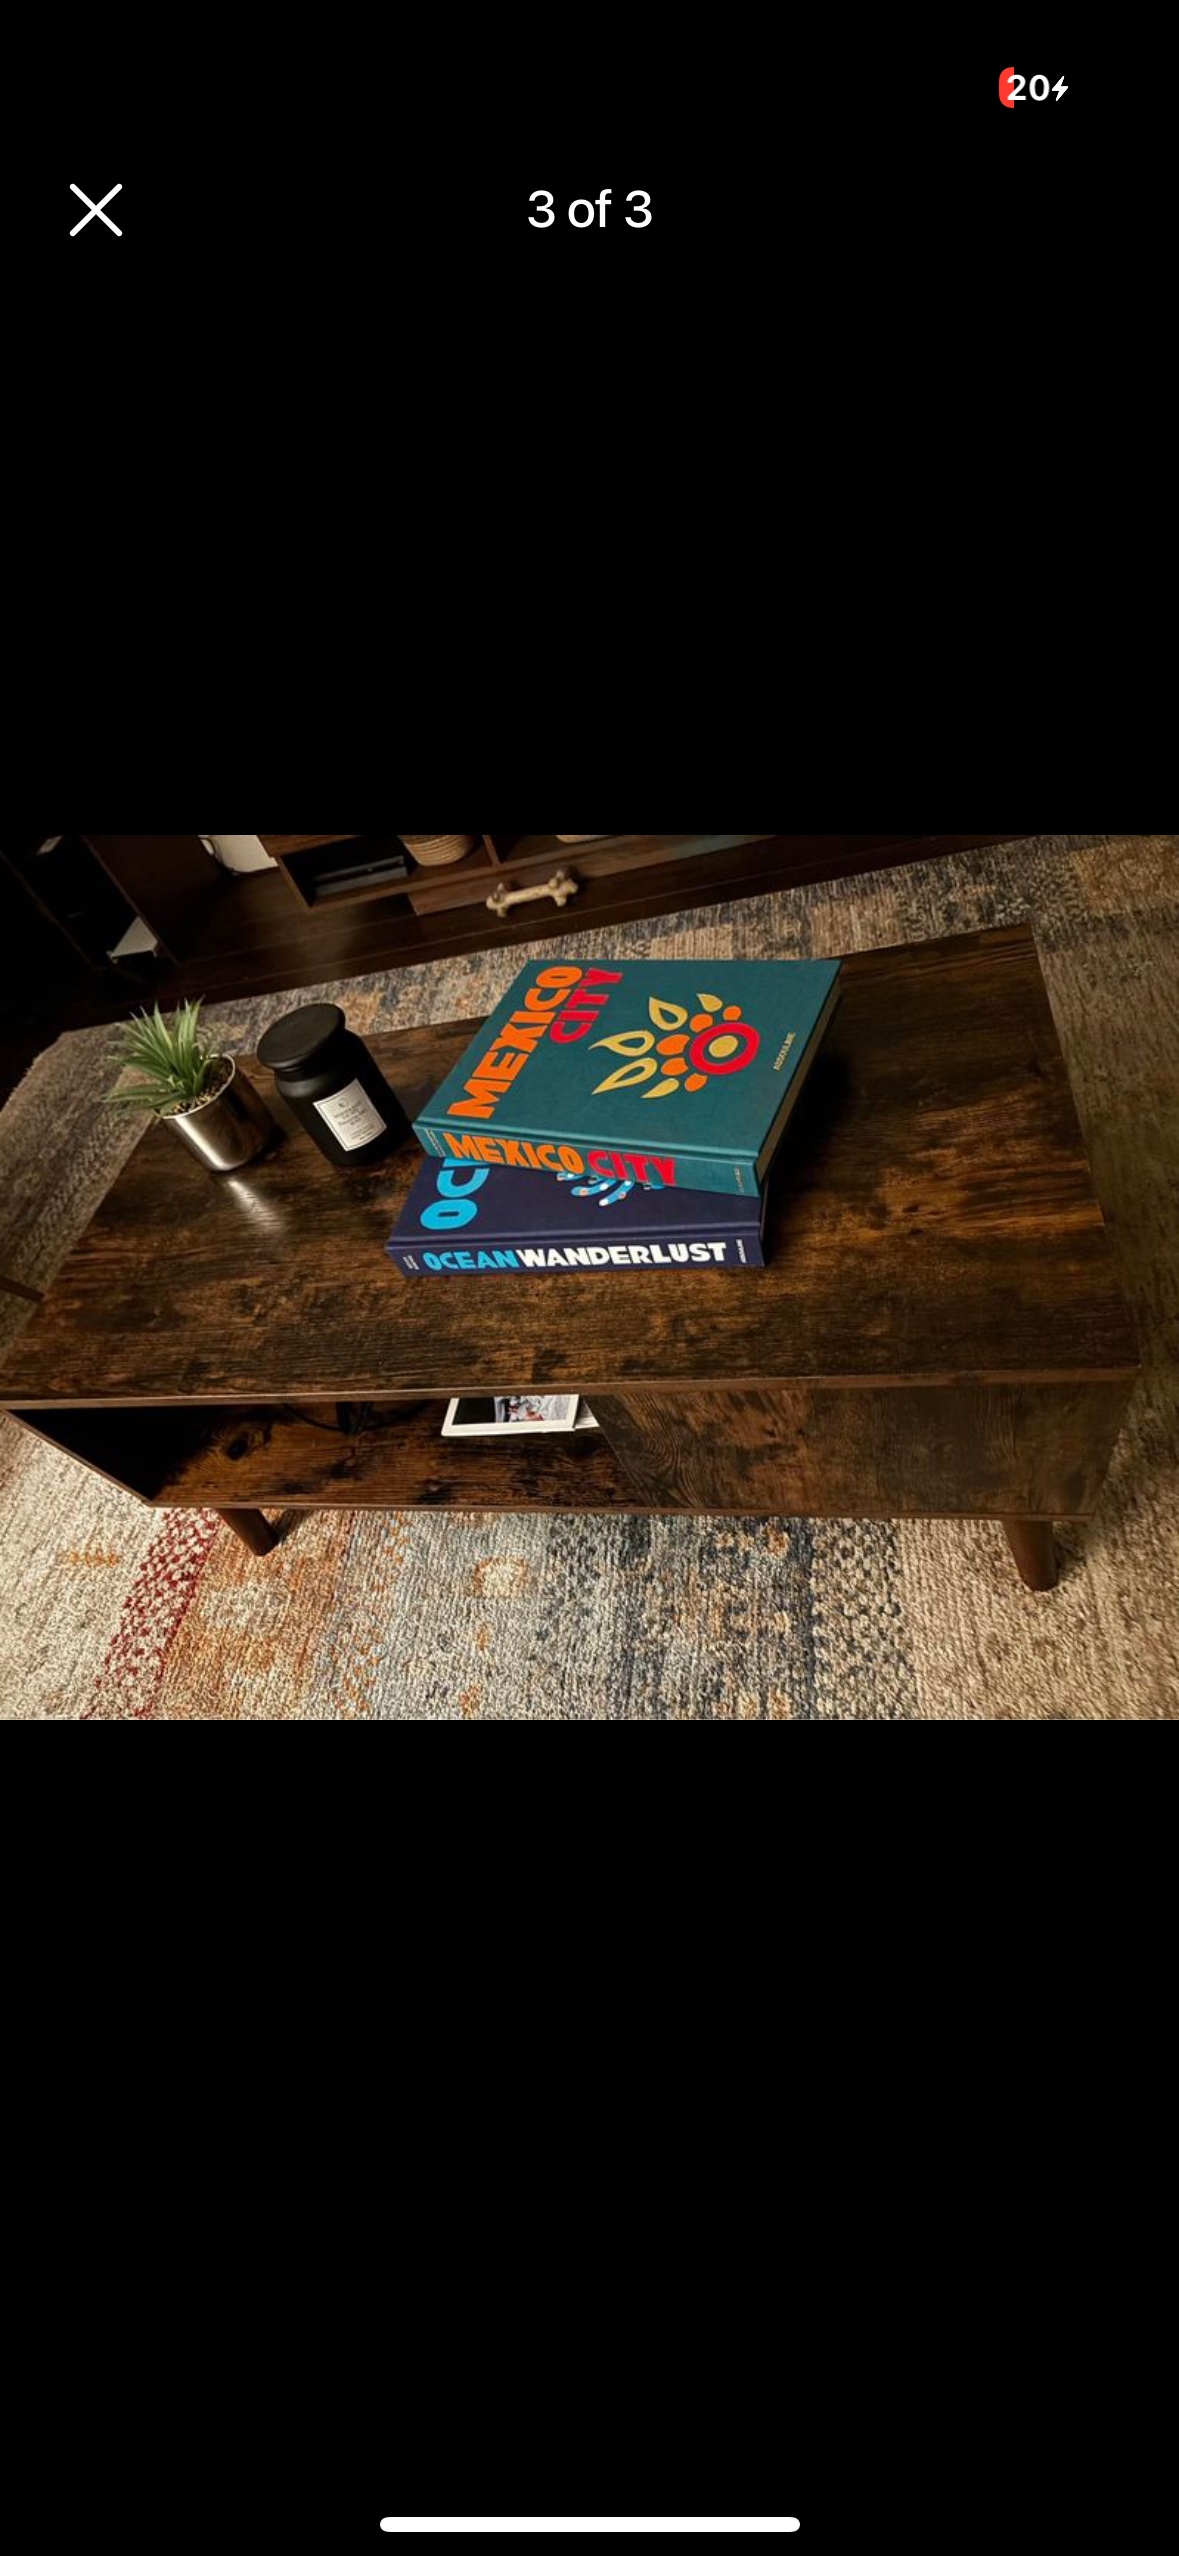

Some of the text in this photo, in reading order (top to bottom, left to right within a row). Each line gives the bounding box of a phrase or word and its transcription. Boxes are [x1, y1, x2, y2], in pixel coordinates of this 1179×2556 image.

[447, 966, 583, 1119] MEXICO
[549, 967, 623, 1044] CITY
[443, 1132, 585, 1174] MEXICO
[587, 1150, 676, 1186] CITY
